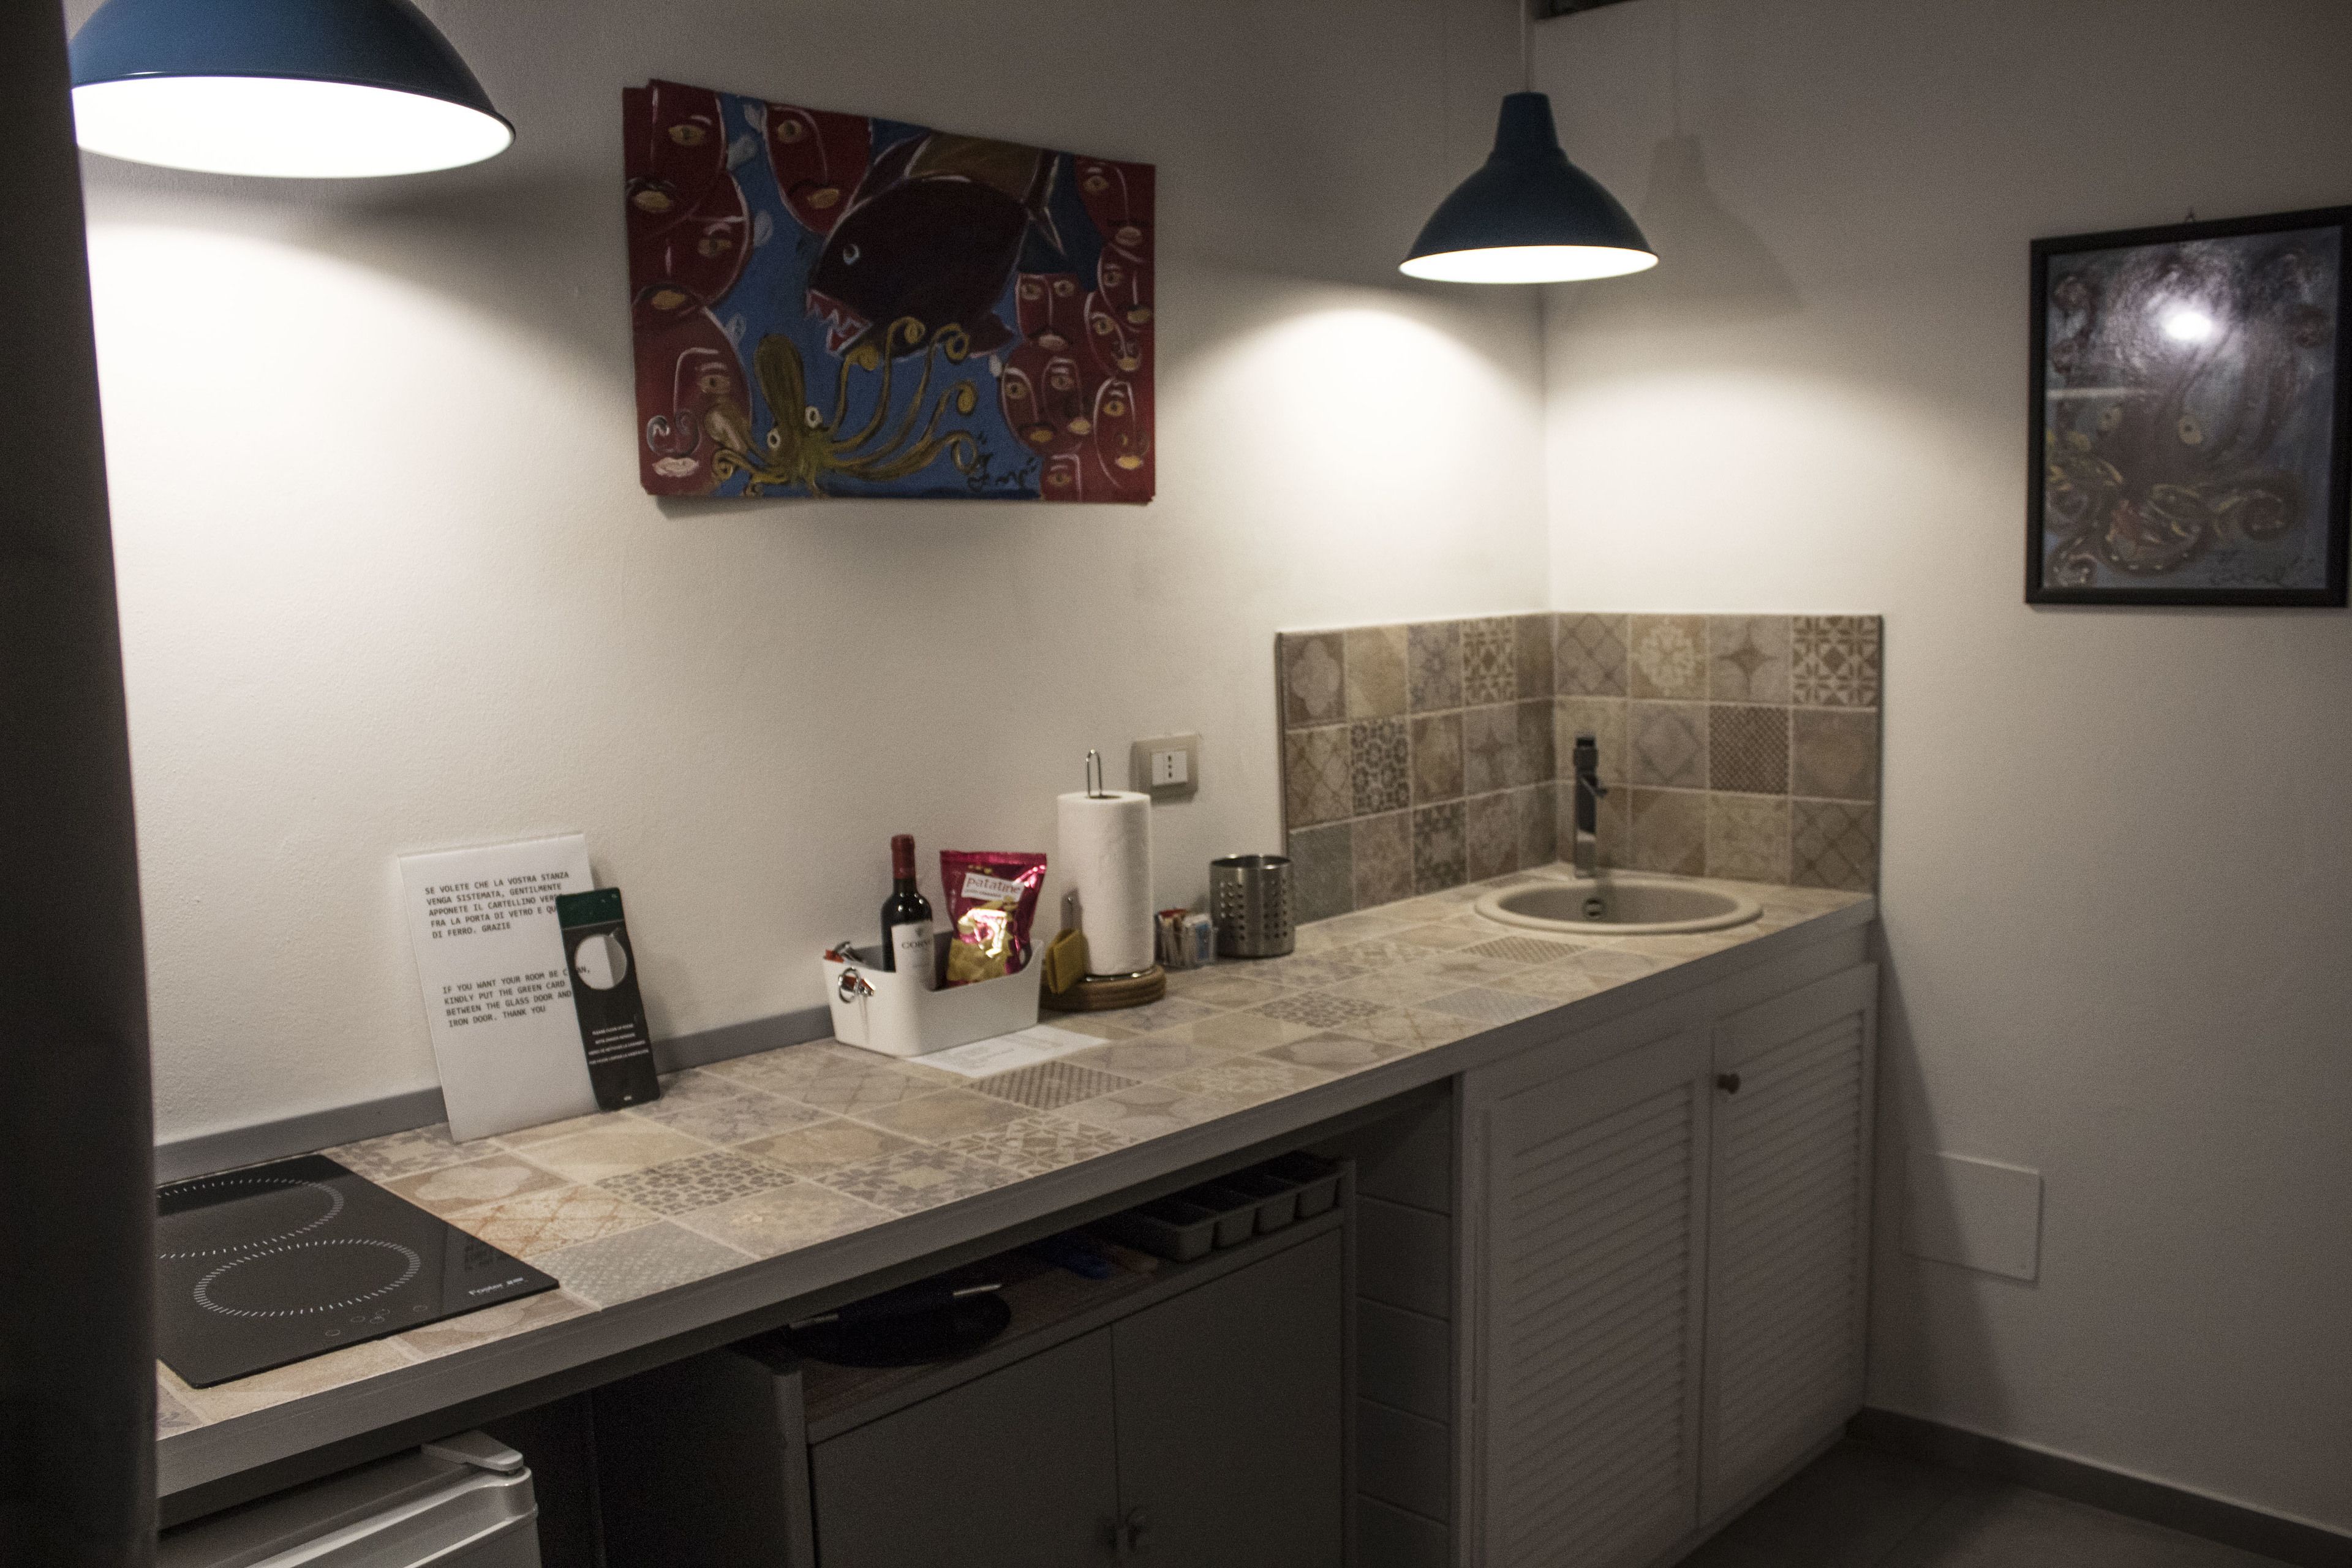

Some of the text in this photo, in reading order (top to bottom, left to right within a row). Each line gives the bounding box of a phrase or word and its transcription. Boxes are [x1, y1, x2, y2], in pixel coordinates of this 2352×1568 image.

[440, 883, 469, 893] VOLETE
[508, 873, 537, 885] VOSTRA
[541, 872, 569, 881] STANZA
[967, 877, 1020, 893] patatine
[427, 883, 561, 906] VENGA SISTEMATA, GENTILMENTE
[429, 906, 468, 917] APPONETE
[488, 897, 535, 910] CARTELLINO
[541, 894, 559, 902] VER
[431, 918, 446, 927] FRA
[466, 914, 490, 923] PORTA
[509, 908, 533, 918] VETRO
[482, 922, 511, 932] GRAZIE
[477, 980, 496, 989] WANT
[501, 976, 521, 986] YOUR
[526, 973, 545, 982] ROOM
[549, 970, 558, 978] BE
[444, 980, 565, 1005] KINDLY PUT THE GREEN CARD
[447, 990, 571, 1016] BETWEEN THE GLASS DOOR AND
[449, 1018, 469, 1028] IRON
[503, 1009, 526, 1019] THANK
[530, 1006, 546, 1014] YOU
